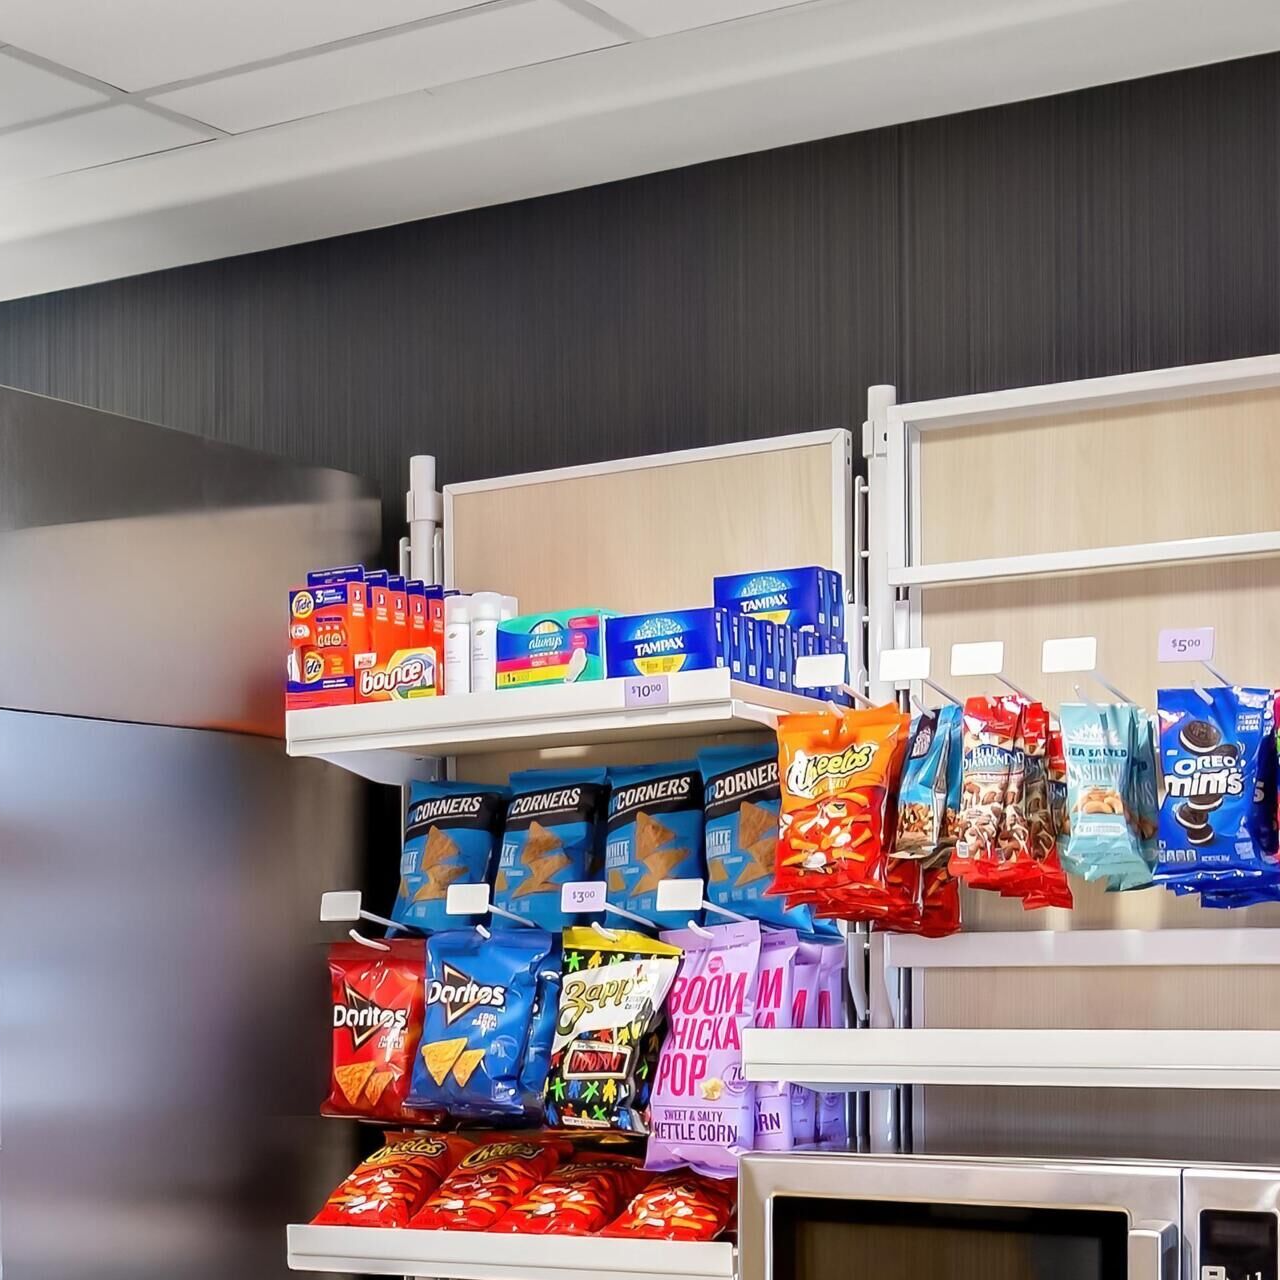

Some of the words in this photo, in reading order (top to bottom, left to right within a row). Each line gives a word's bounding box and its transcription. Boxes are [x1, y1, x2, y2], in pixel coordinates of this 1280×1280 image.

[740, 593, 788, 613] TAMPAX
[528, 632, 564, 651] always
[634, 635, 684, 658] TAMPAX
[361, 660, 424, 696] bounce
[972, 746, 998, 758] BLUE
[1088, 748, 1127, 758] SALTED
[787, 742, 877, 797] Cheetos
[1174, 755, 1236, 775] OREO
[427, 980, 507, 1007] Doritos
[670, 971, 749, 1016] BOOM
[333, 1003, 408, 1028] Doritos
[656, 1052, 708, 1097] POP
[664, 1109, 687, 1121] SWEET
[689, 1110, 695, 1121] &
[697, 1111, 723, 1122] SALTY
[654, 1121, 701, 1142] KETTLE
[703, 1124, 738, 1143] CORN
